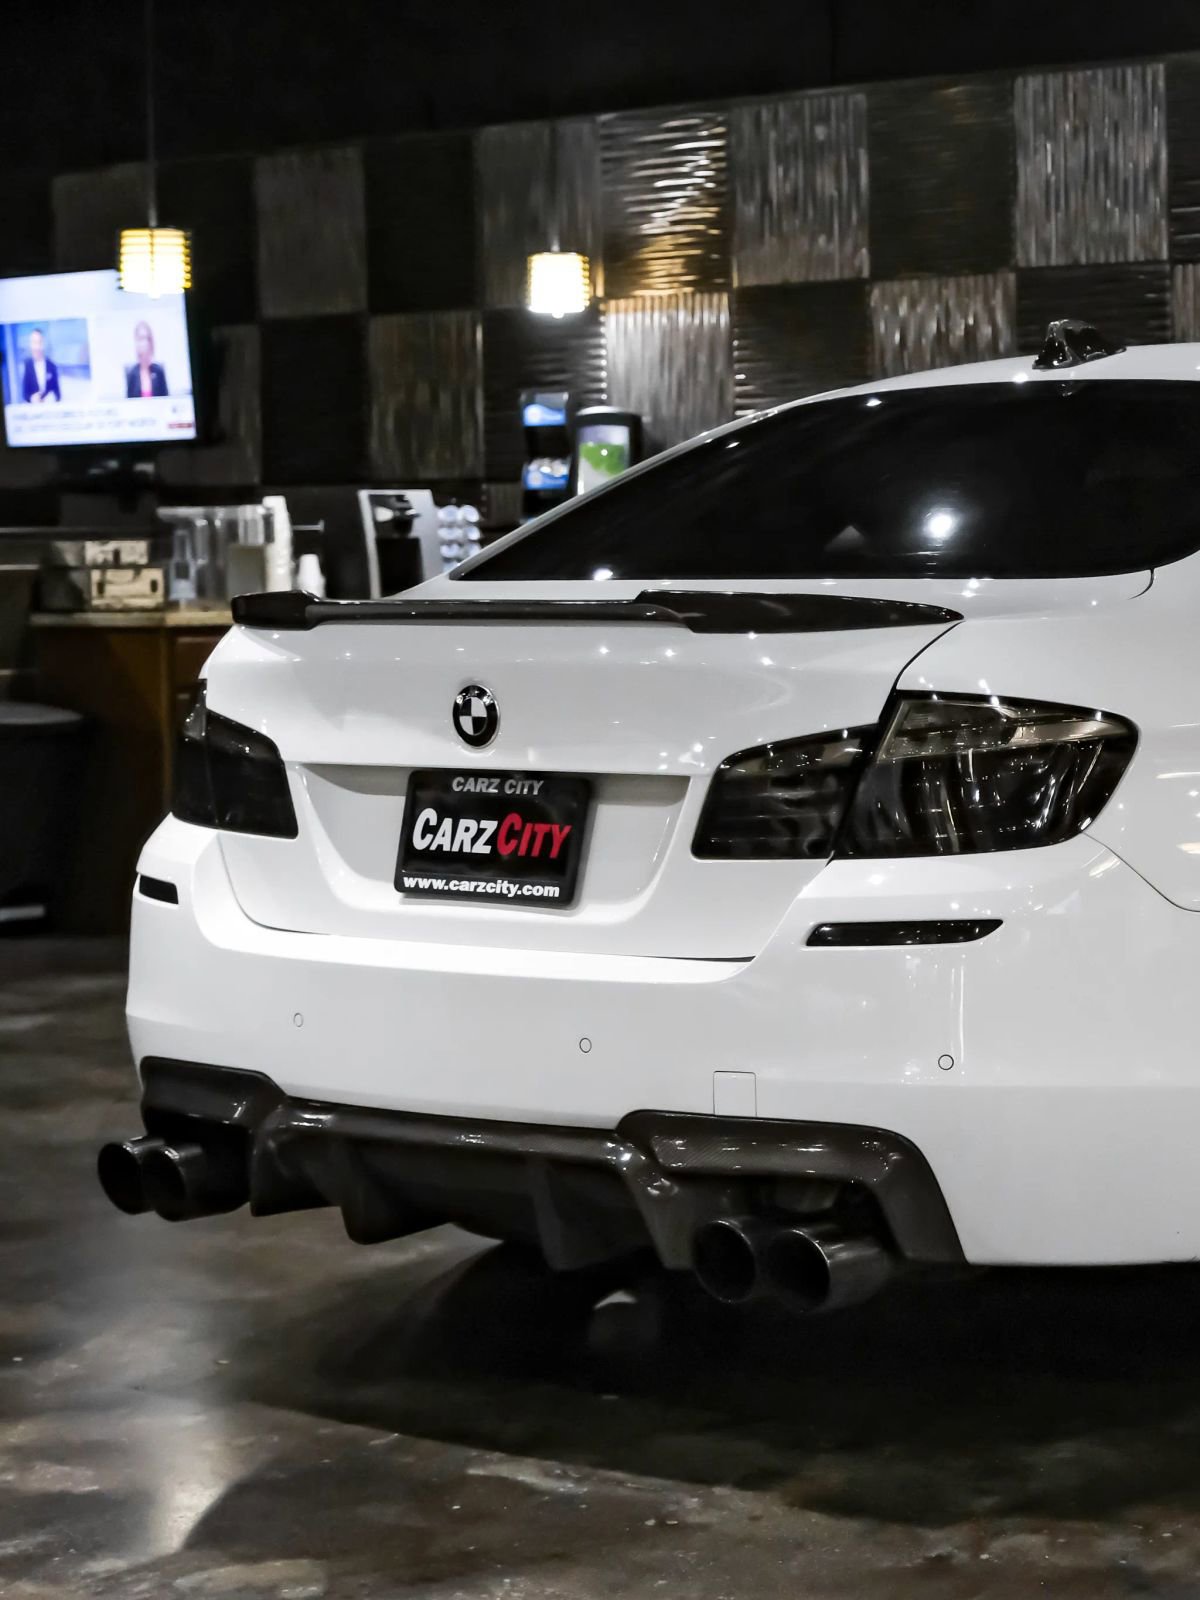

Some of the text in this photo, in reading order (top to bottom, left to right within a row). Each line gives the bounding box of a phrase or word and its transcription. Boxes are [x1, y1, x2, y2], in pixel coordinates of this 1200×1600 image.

[452, 777, 544, 795] CARZ CITY
[403, 877, 560, 897] www.carzcity.com
